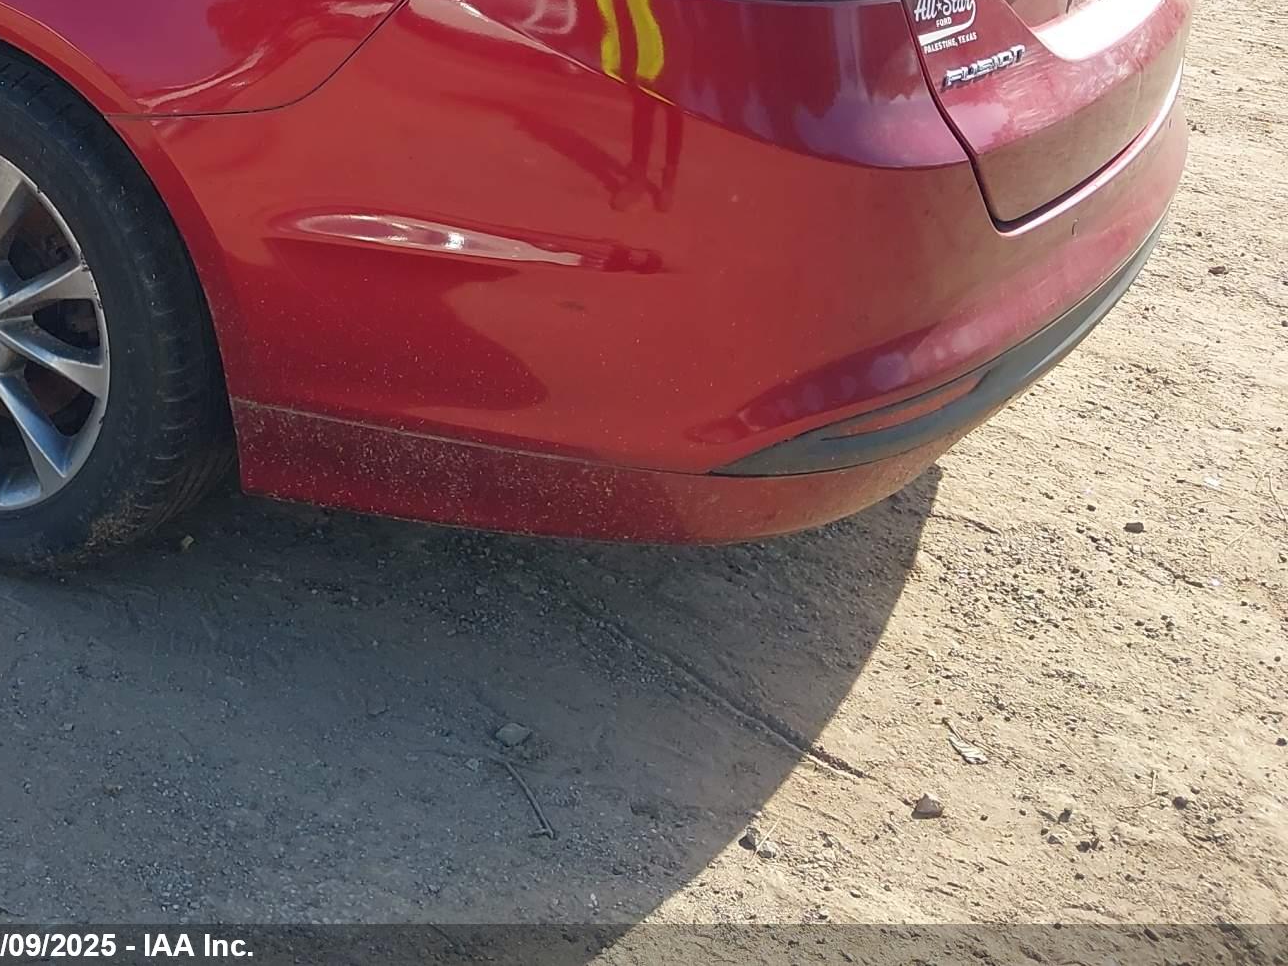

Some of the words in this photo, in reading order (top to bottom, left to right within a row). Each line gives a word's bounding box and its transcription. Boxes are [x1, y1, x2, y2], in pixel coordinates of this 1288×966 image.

[936, 16, 953, 28] FORD
[958, 32, 978, 45] TEXAS
[943, 44, 1026, 87] FUSION
